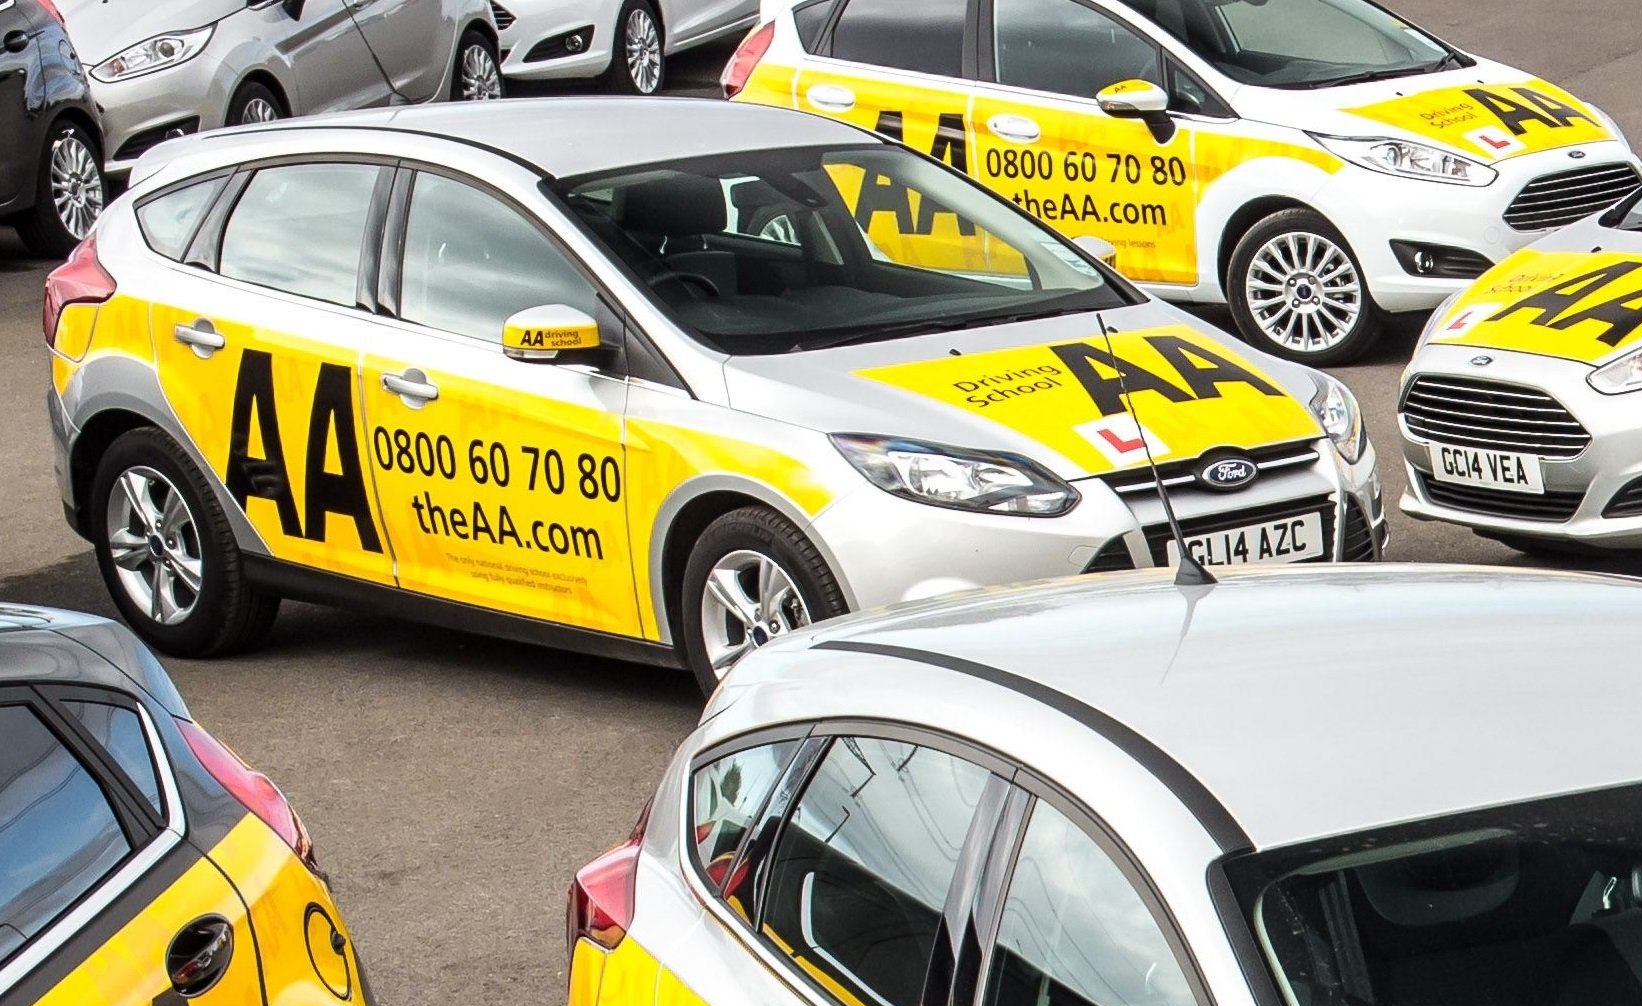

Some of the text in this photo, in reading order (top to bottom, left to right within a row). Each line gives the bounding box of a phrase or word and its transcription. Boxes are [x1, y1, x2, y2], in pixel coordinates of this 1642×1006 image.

[1419, 102, 1474, 122] Driving
[1430, 111, 1476, 130] School
[1462, 87, 1603, 136] AA
[1479, 134, 1511, 150] L
[986, 146, 1186, 187] 0800 60 70 80
[1446, 311, 1473, 331] L
[520, 330, 579, 347] AA driving
[551, 338, 582, 347] school
[953, 364, 1062, 394] Driving
[1049, 335, 1289, 417] AA
[965, 376, 1063, 408] School
[225, 349, 384, 555] AA
[1096, 427, 1146, 453] L
[373, 425, 621, 503] 0800 60 70 80
[1217, 462, 1247, 481] Ford
[1441, 446, 1529, 485] GC14 VEA
[411, 490, 604, 560] theAA.com
[1187, 519, 1307, 566] GL14 AZC
